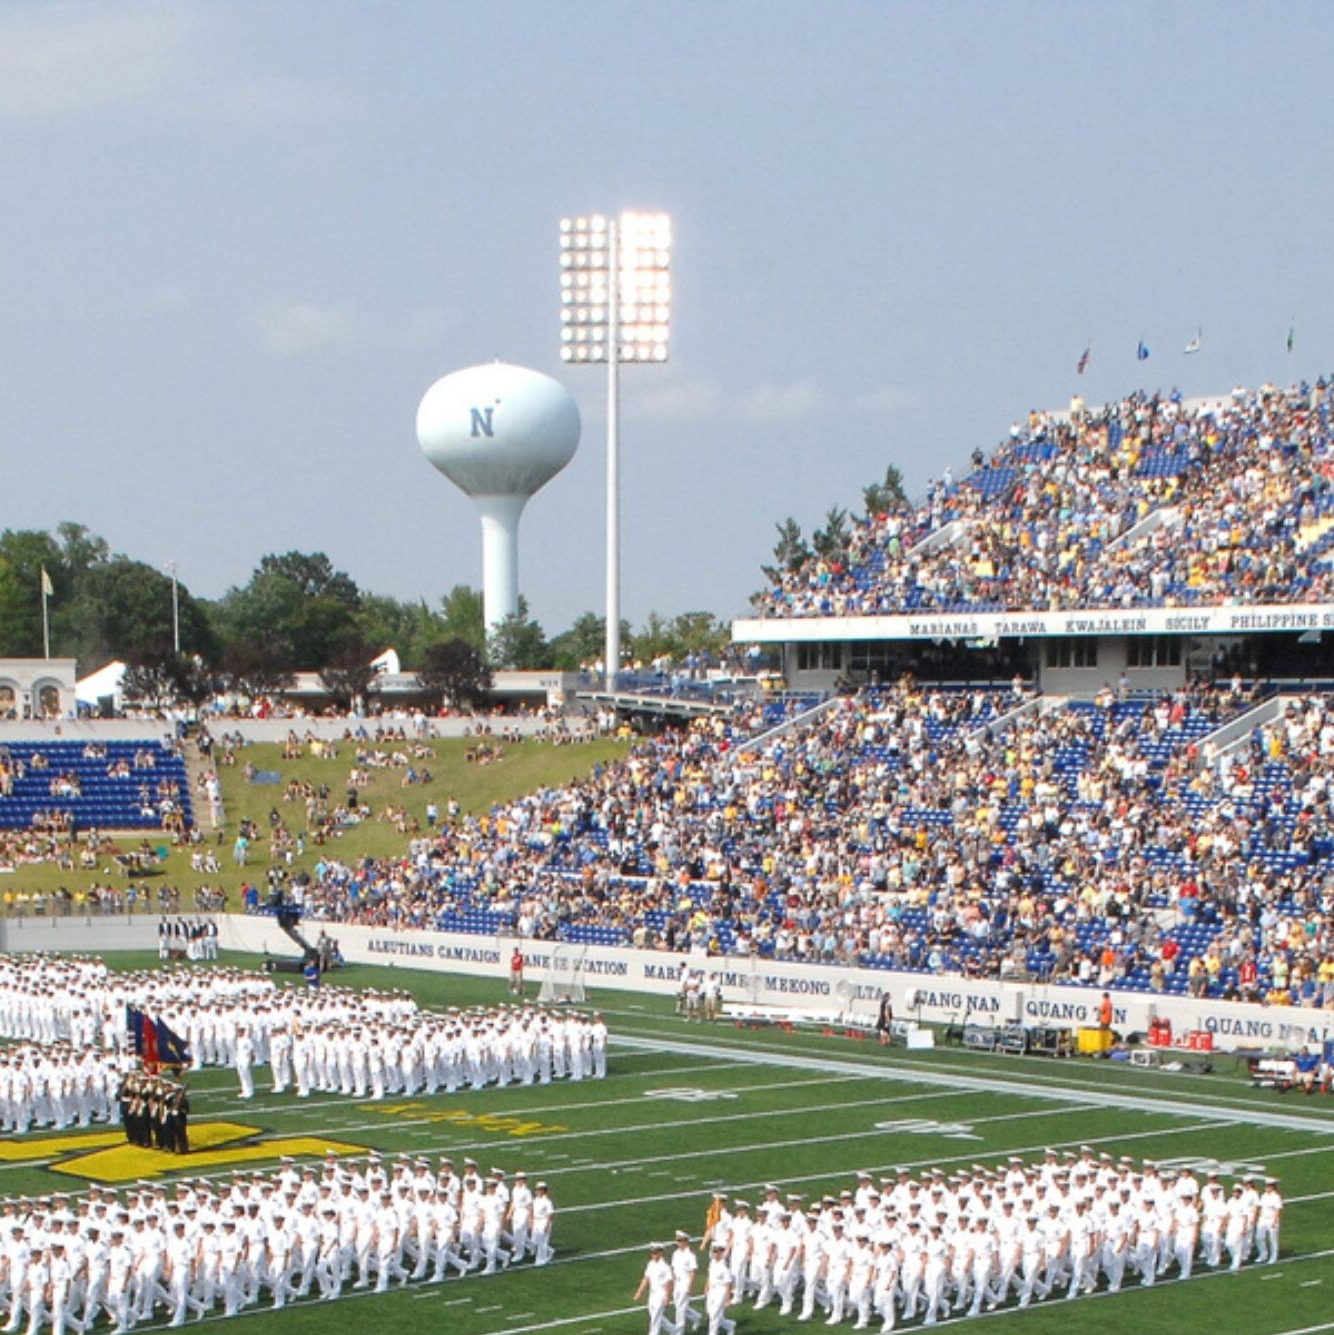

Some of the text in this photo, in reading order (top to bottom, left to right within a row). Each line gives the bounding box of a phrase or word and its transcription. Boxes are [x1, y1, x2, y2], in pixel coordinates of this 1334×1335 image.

[470, 407, 494, 437] N
[909, 622, 978, 635] MARIANAS
[994, 620, 1046, 634] TARAWA
[1066, 618, 1147, 632] KWAJALEIN
[1165, 616, 1211, 631] SICILY
[1231, 613, 1317, 629] PHILIPPINE
[368, 940, 501, 964] ALEUTIANS CAMPAIGN
[764, 976, 830, 996] MEKONG
[1027, 1001, 1086, 1021] QUANG
[1205, 1016, 1272, 1038] QUANG
